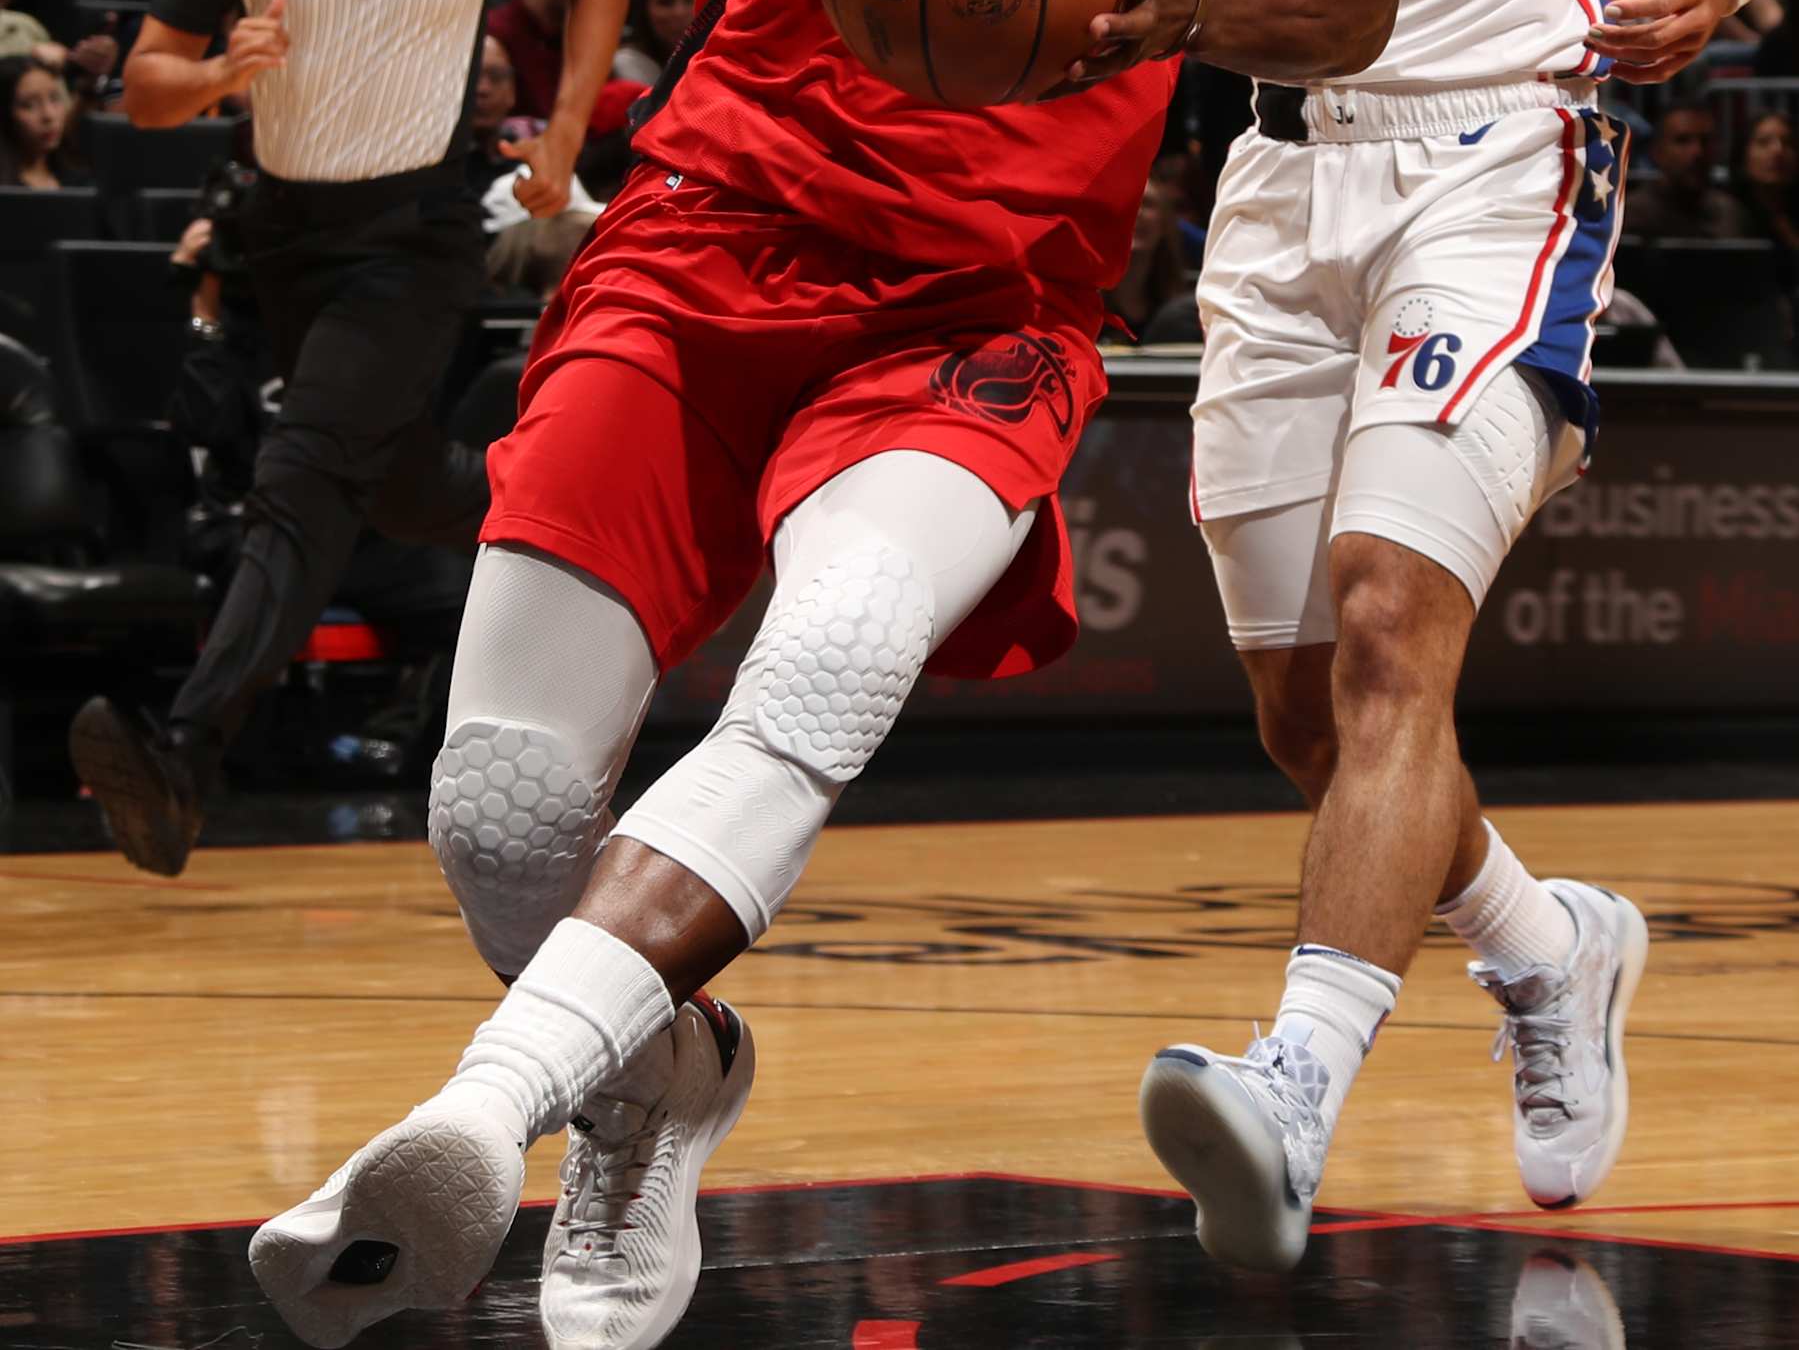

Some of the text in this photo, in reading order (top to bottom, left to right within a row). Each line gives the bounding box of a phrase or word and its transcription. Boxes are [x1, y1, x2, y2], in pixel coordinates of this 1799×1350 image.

[1380, 331, 1463, 392] 76
[1506, 571, 1576, 644] of
[1582, 569, 1683, 644] the
